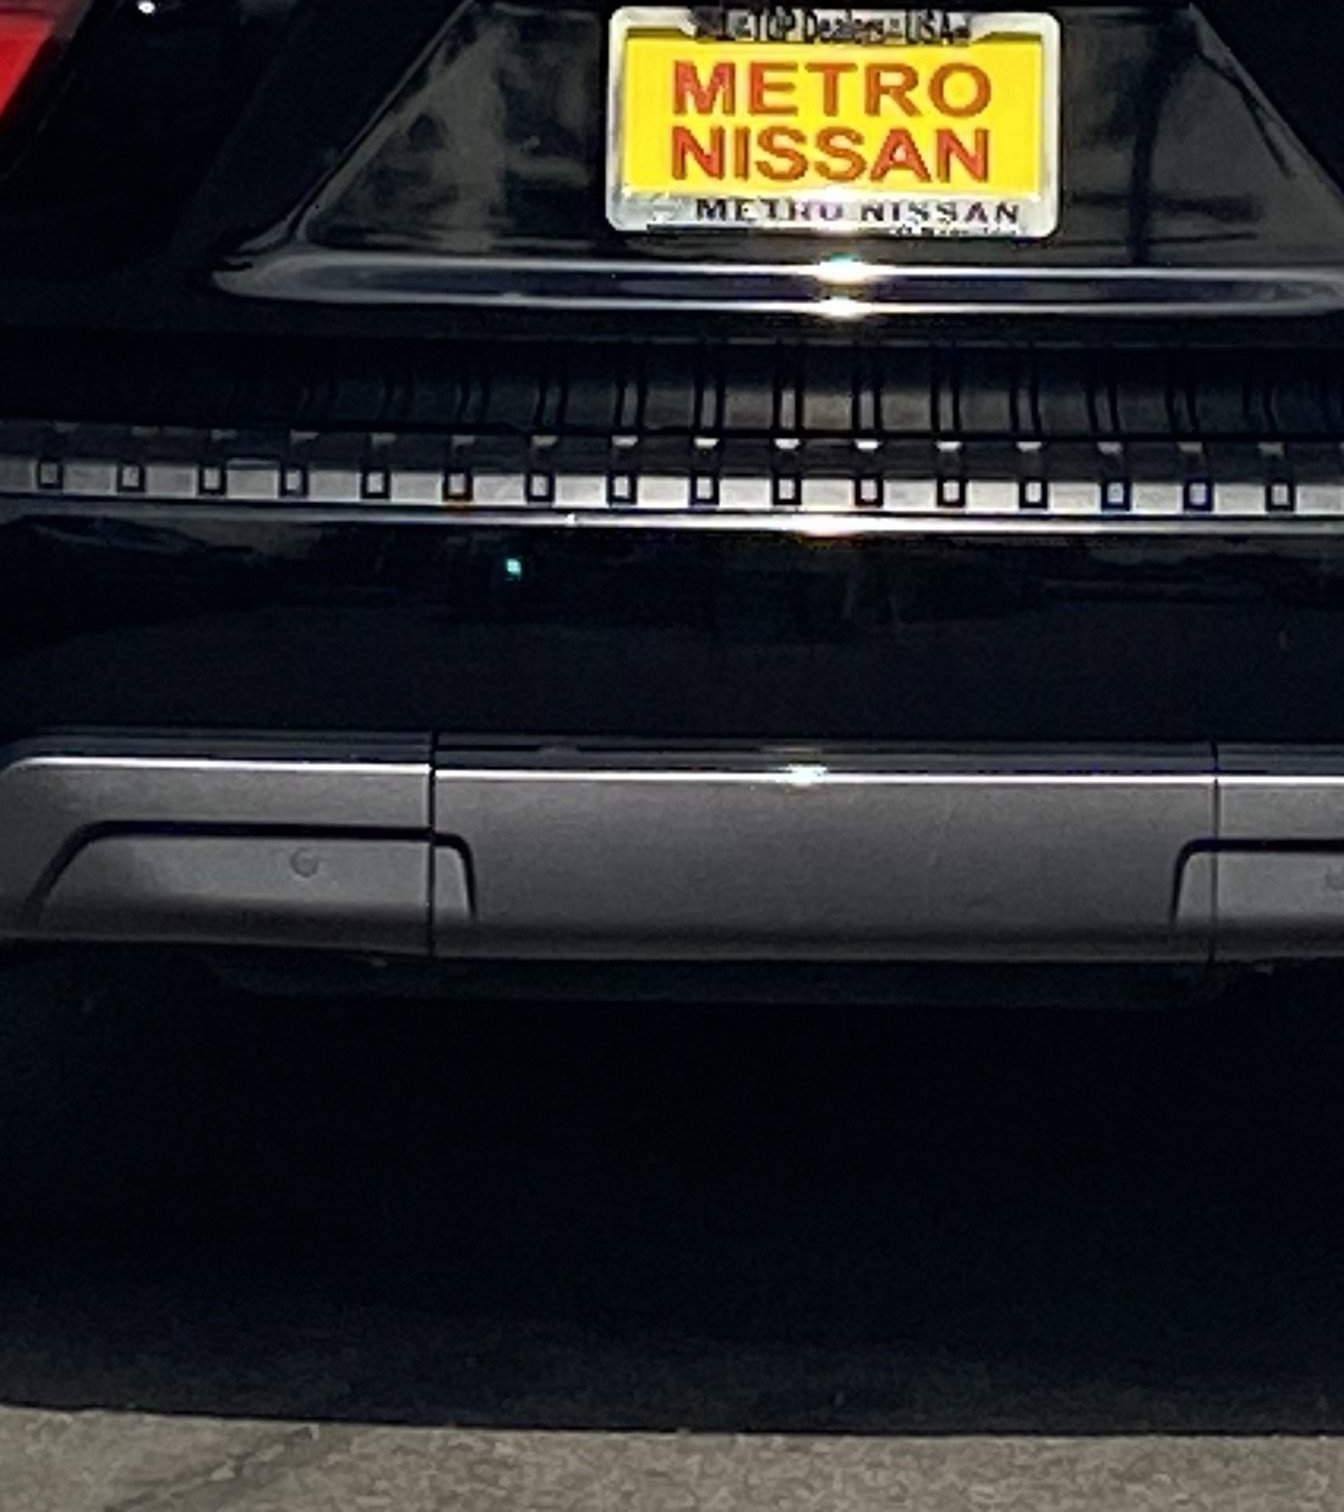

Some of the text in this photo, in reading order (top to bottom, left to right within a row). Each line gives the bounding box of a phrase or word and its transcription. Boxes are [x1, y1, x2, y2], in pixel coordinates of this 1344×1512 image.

[672, 59, 992, 118] METRO
[671, 125, 991, 183] NISSAN
[695, 198, 1020, 225] METRO NISSAN
